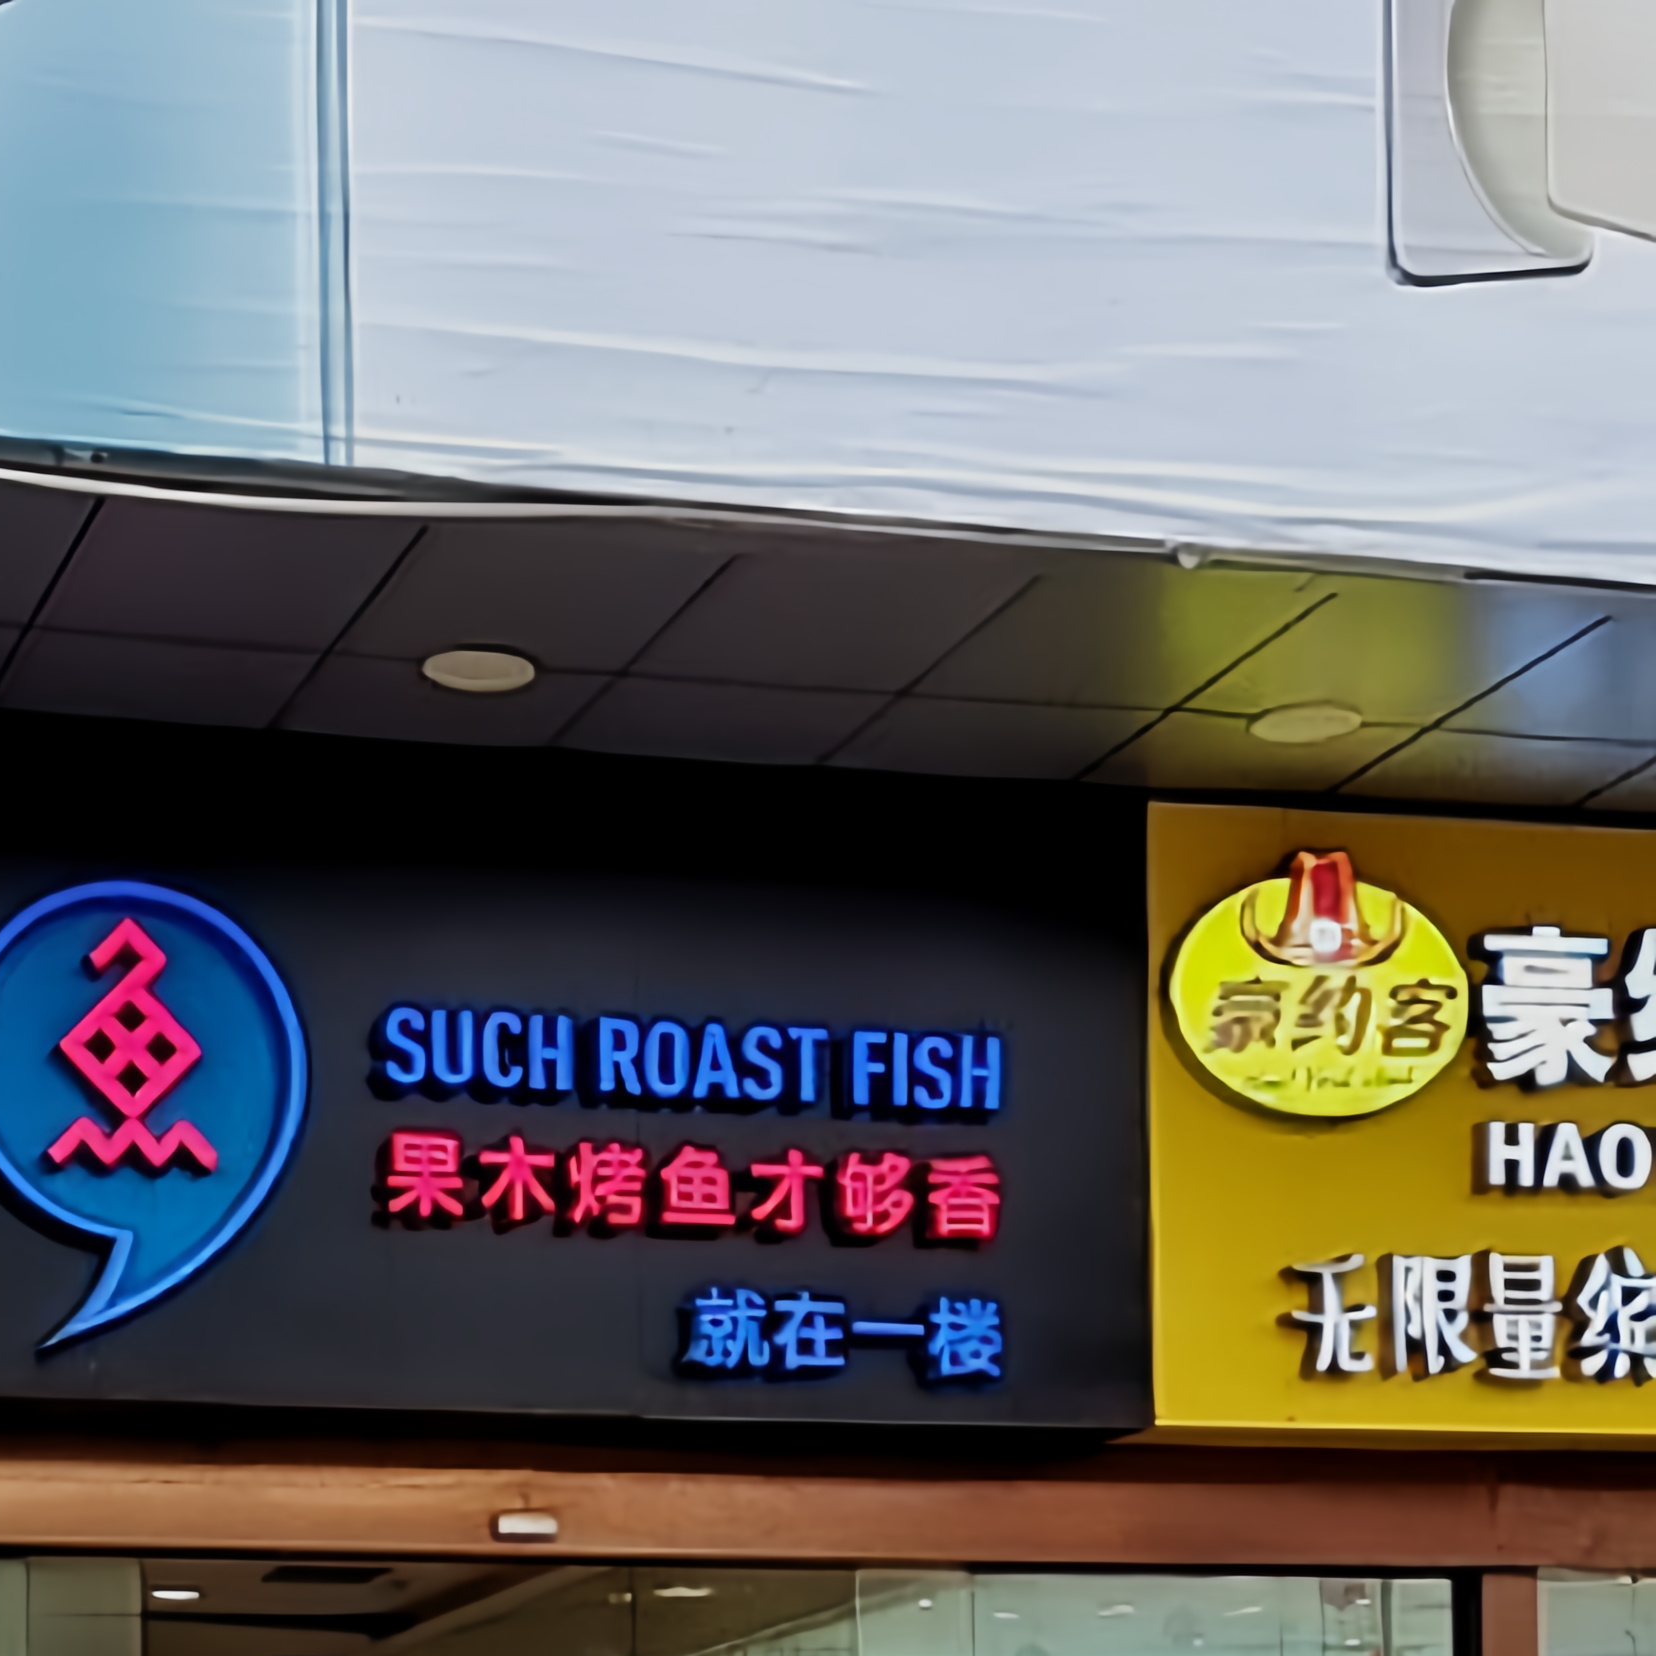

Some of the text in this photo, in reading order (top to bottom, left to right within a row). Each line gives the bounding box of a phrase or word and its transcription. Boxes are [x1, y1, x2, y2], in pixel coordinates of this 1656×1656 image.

[385, 1006, 1001, 1111] SUCH ROAST FISH
[1482, 926, 1656, 1088] 豪
[386, 1131, 1001, 1242] 果木烤鱼才够香
[1488, 1121, 1652, 1190] HAO
[682, 1287, 1002, 1380] 就在一楼
